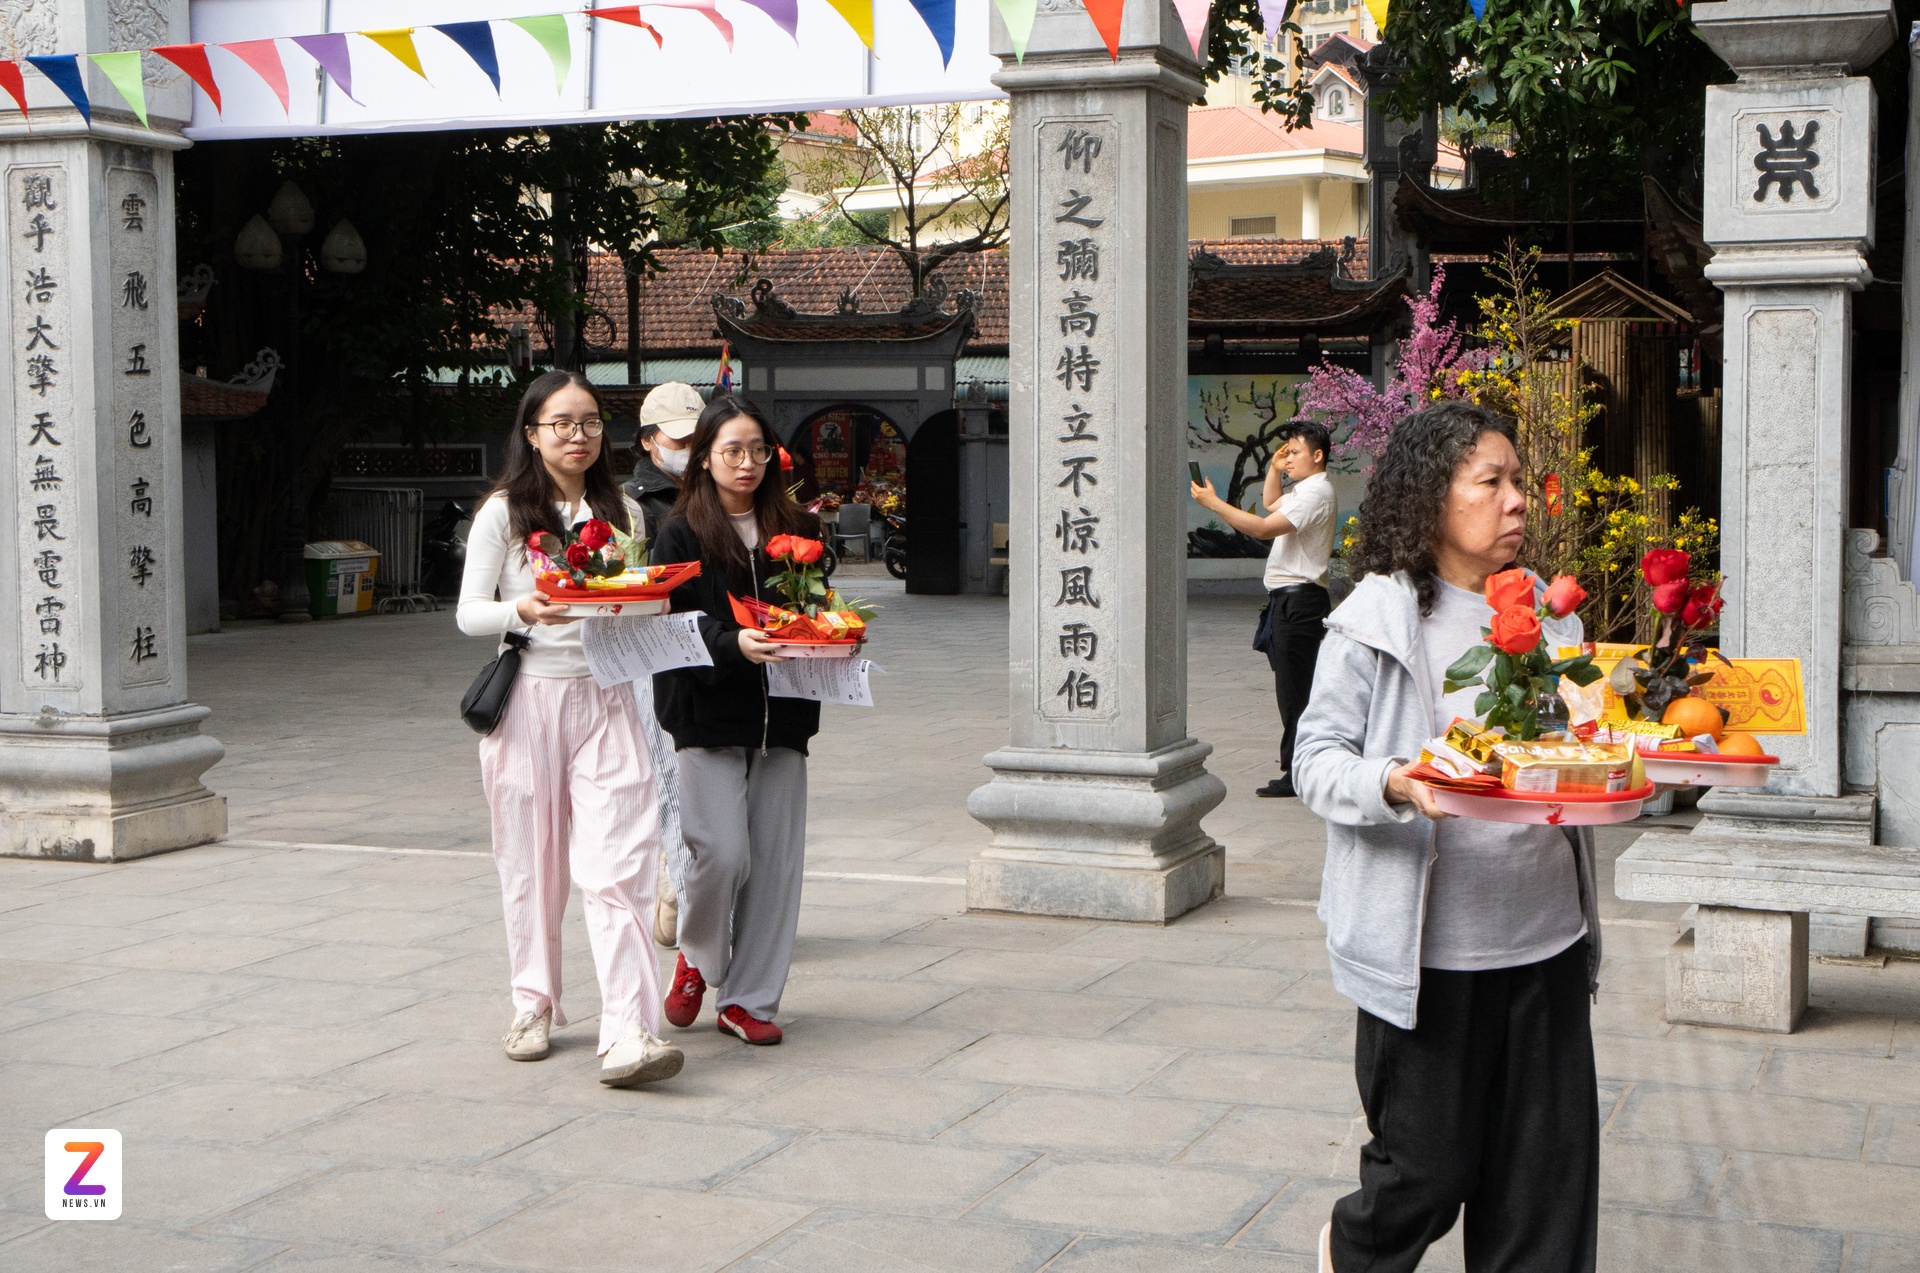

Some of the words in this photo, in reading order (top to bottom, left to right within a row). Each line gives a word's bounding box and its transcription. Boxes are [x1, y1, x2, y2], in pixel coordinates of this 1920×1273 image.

[121, 193, 157, 663] 雲飛五色高擎柱
